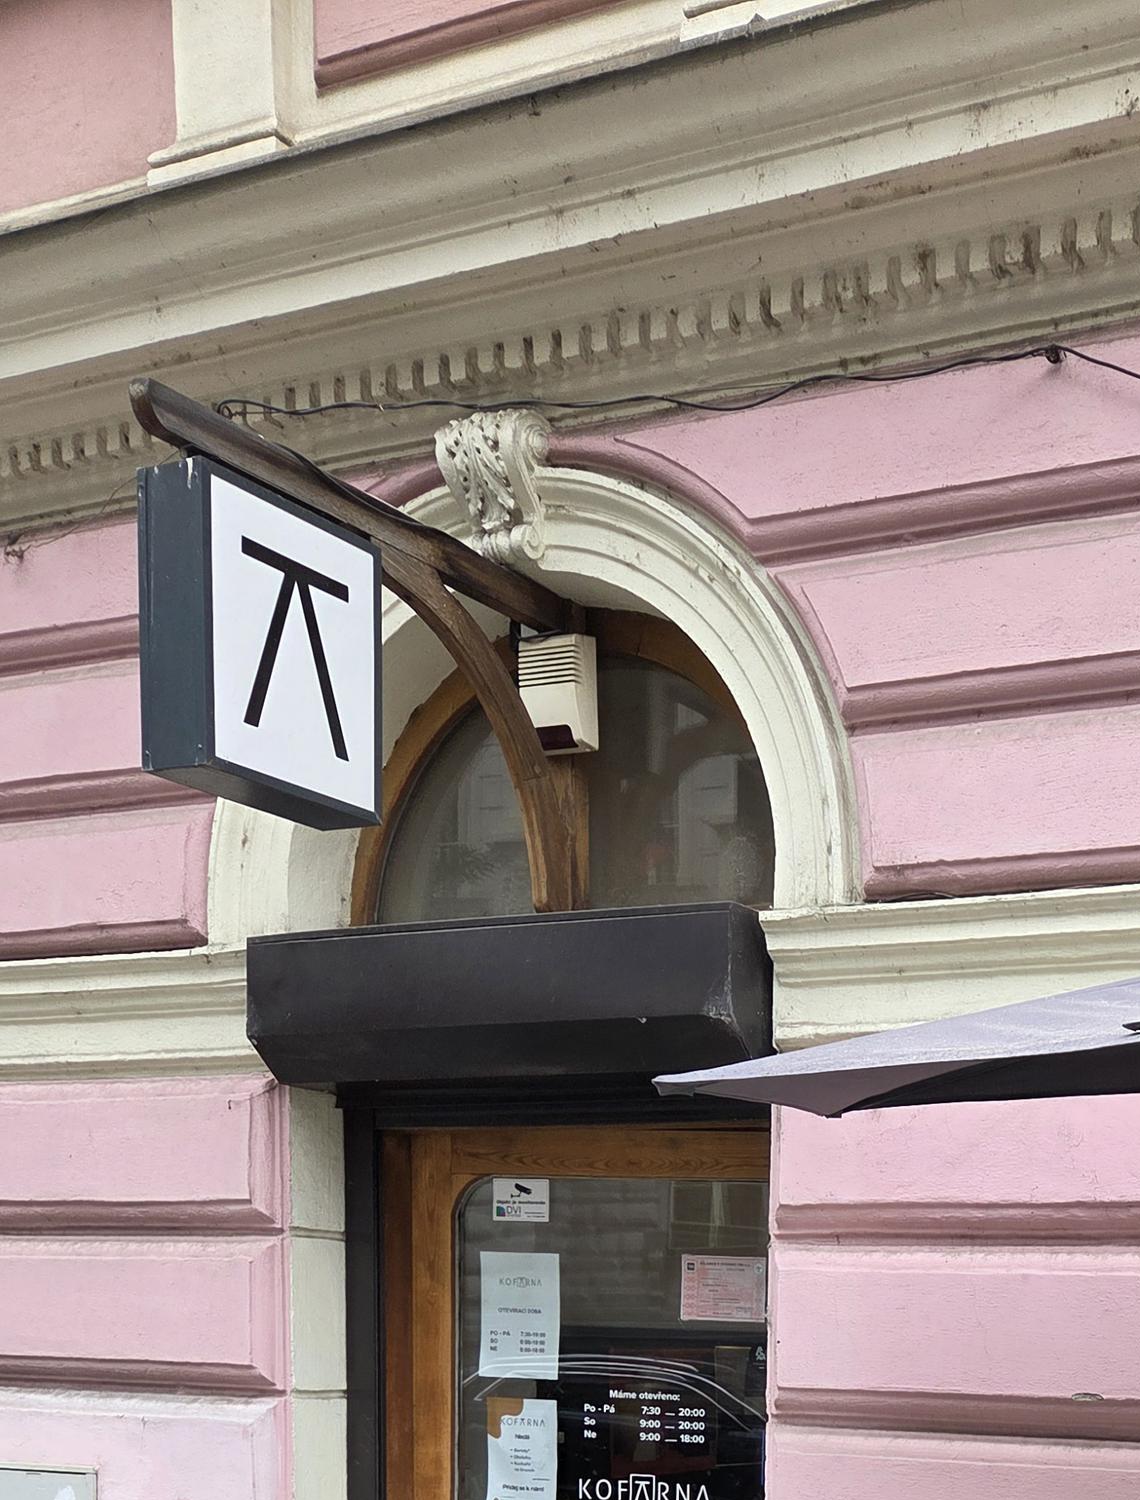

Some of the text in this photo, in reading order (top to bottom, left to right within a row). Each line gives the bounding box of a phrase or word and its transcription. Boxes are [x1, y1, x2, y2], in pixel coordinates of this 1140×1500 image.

[609, 1389, 681, 1401] Máme otevřeno:
[583, 1403, 596, 1413] Po
[603, 1403, 616, 1413] Pá
[641, 1406, 661, 1416] 7:30
[678, 1407, 706, 1418] 20:00
[583, 1416, 596, 1426] So
[639, 1418, 661, 1429] 9:00
[678, 1420, 705, 1431] 20:00
[583, 1429, 597, 1439] Ne
[639, 1432, 661, 1441] 9:00
[680, 1433, 705, 1444] 18:00
